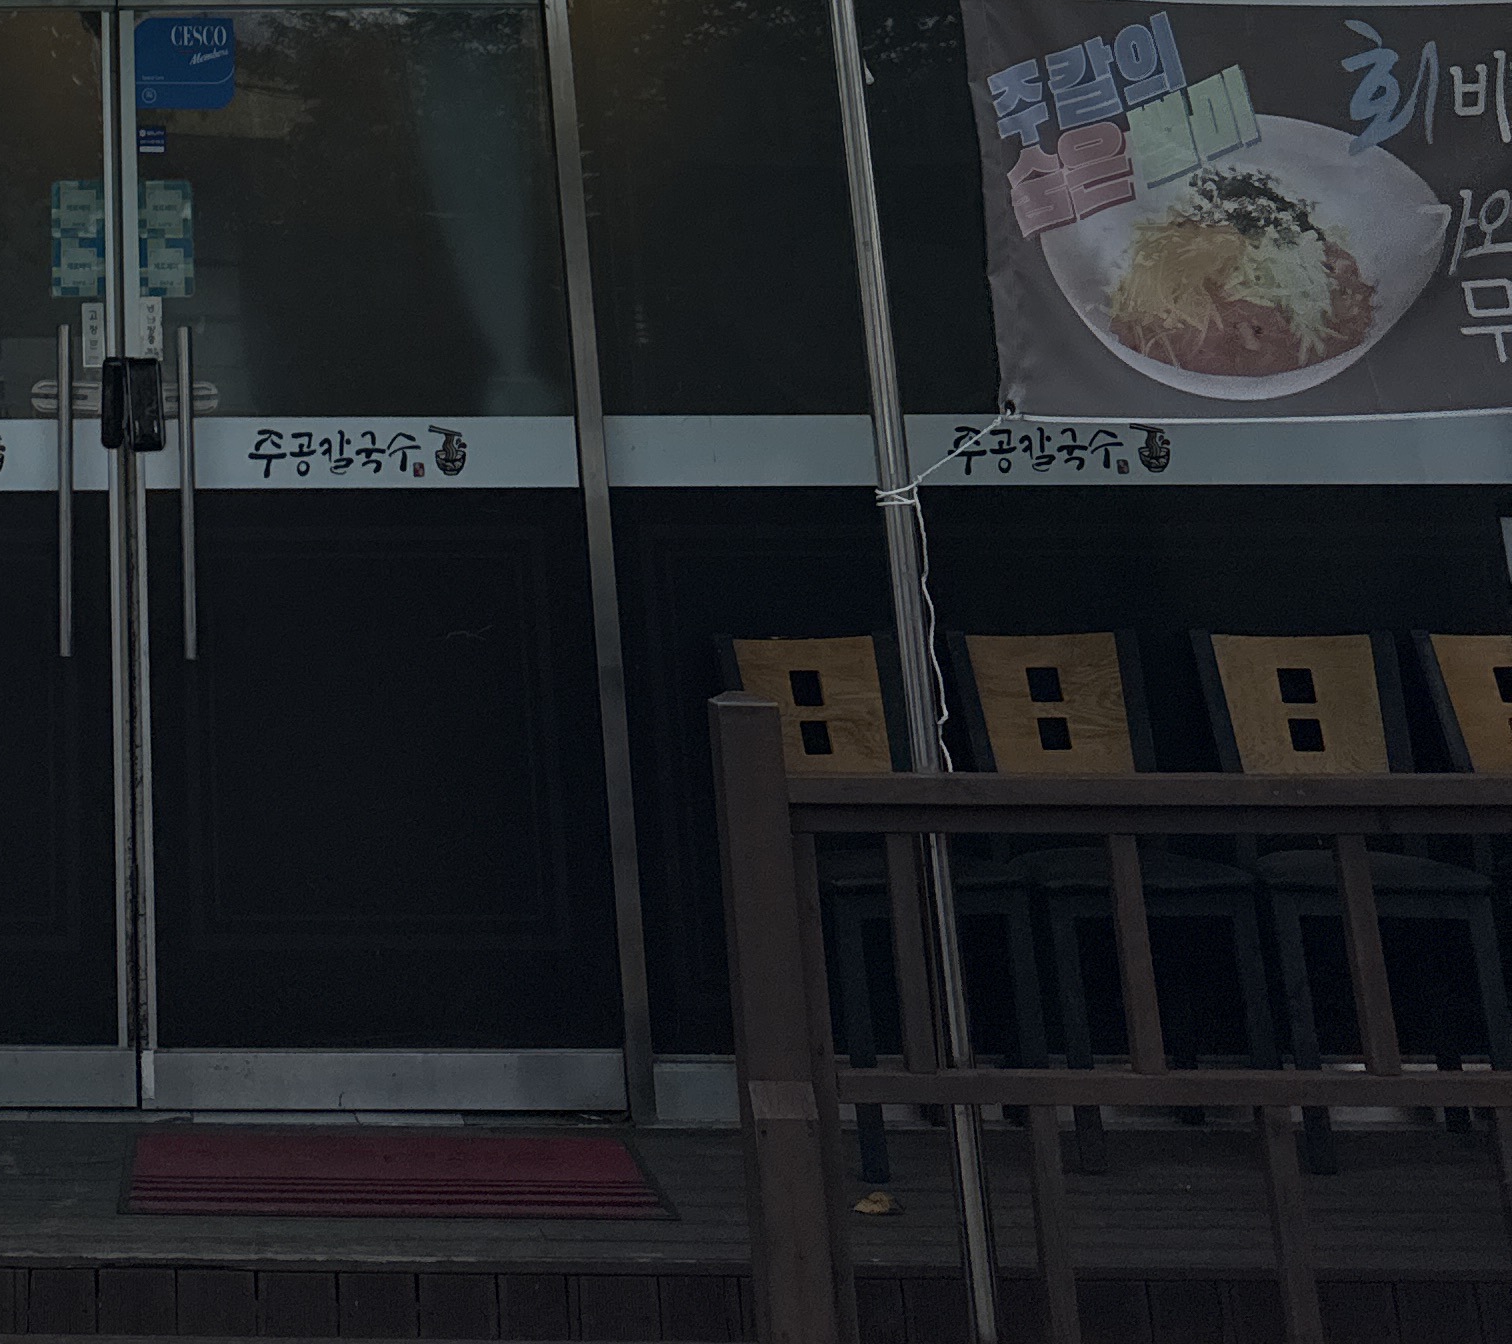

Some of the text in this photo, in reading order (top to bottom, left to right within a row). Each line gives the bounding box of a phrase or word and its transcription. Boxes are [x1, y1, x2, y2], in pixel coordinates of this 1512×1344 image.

[170, 25, 227, 47] CESCO
[987, 10, 1187, 146] 주칼의
[1007, 121, 1136, 239] 숨은
[248, 428, 422, 479] 주공칼국수
[948, 426, 1124, 476] 주공칼국수
